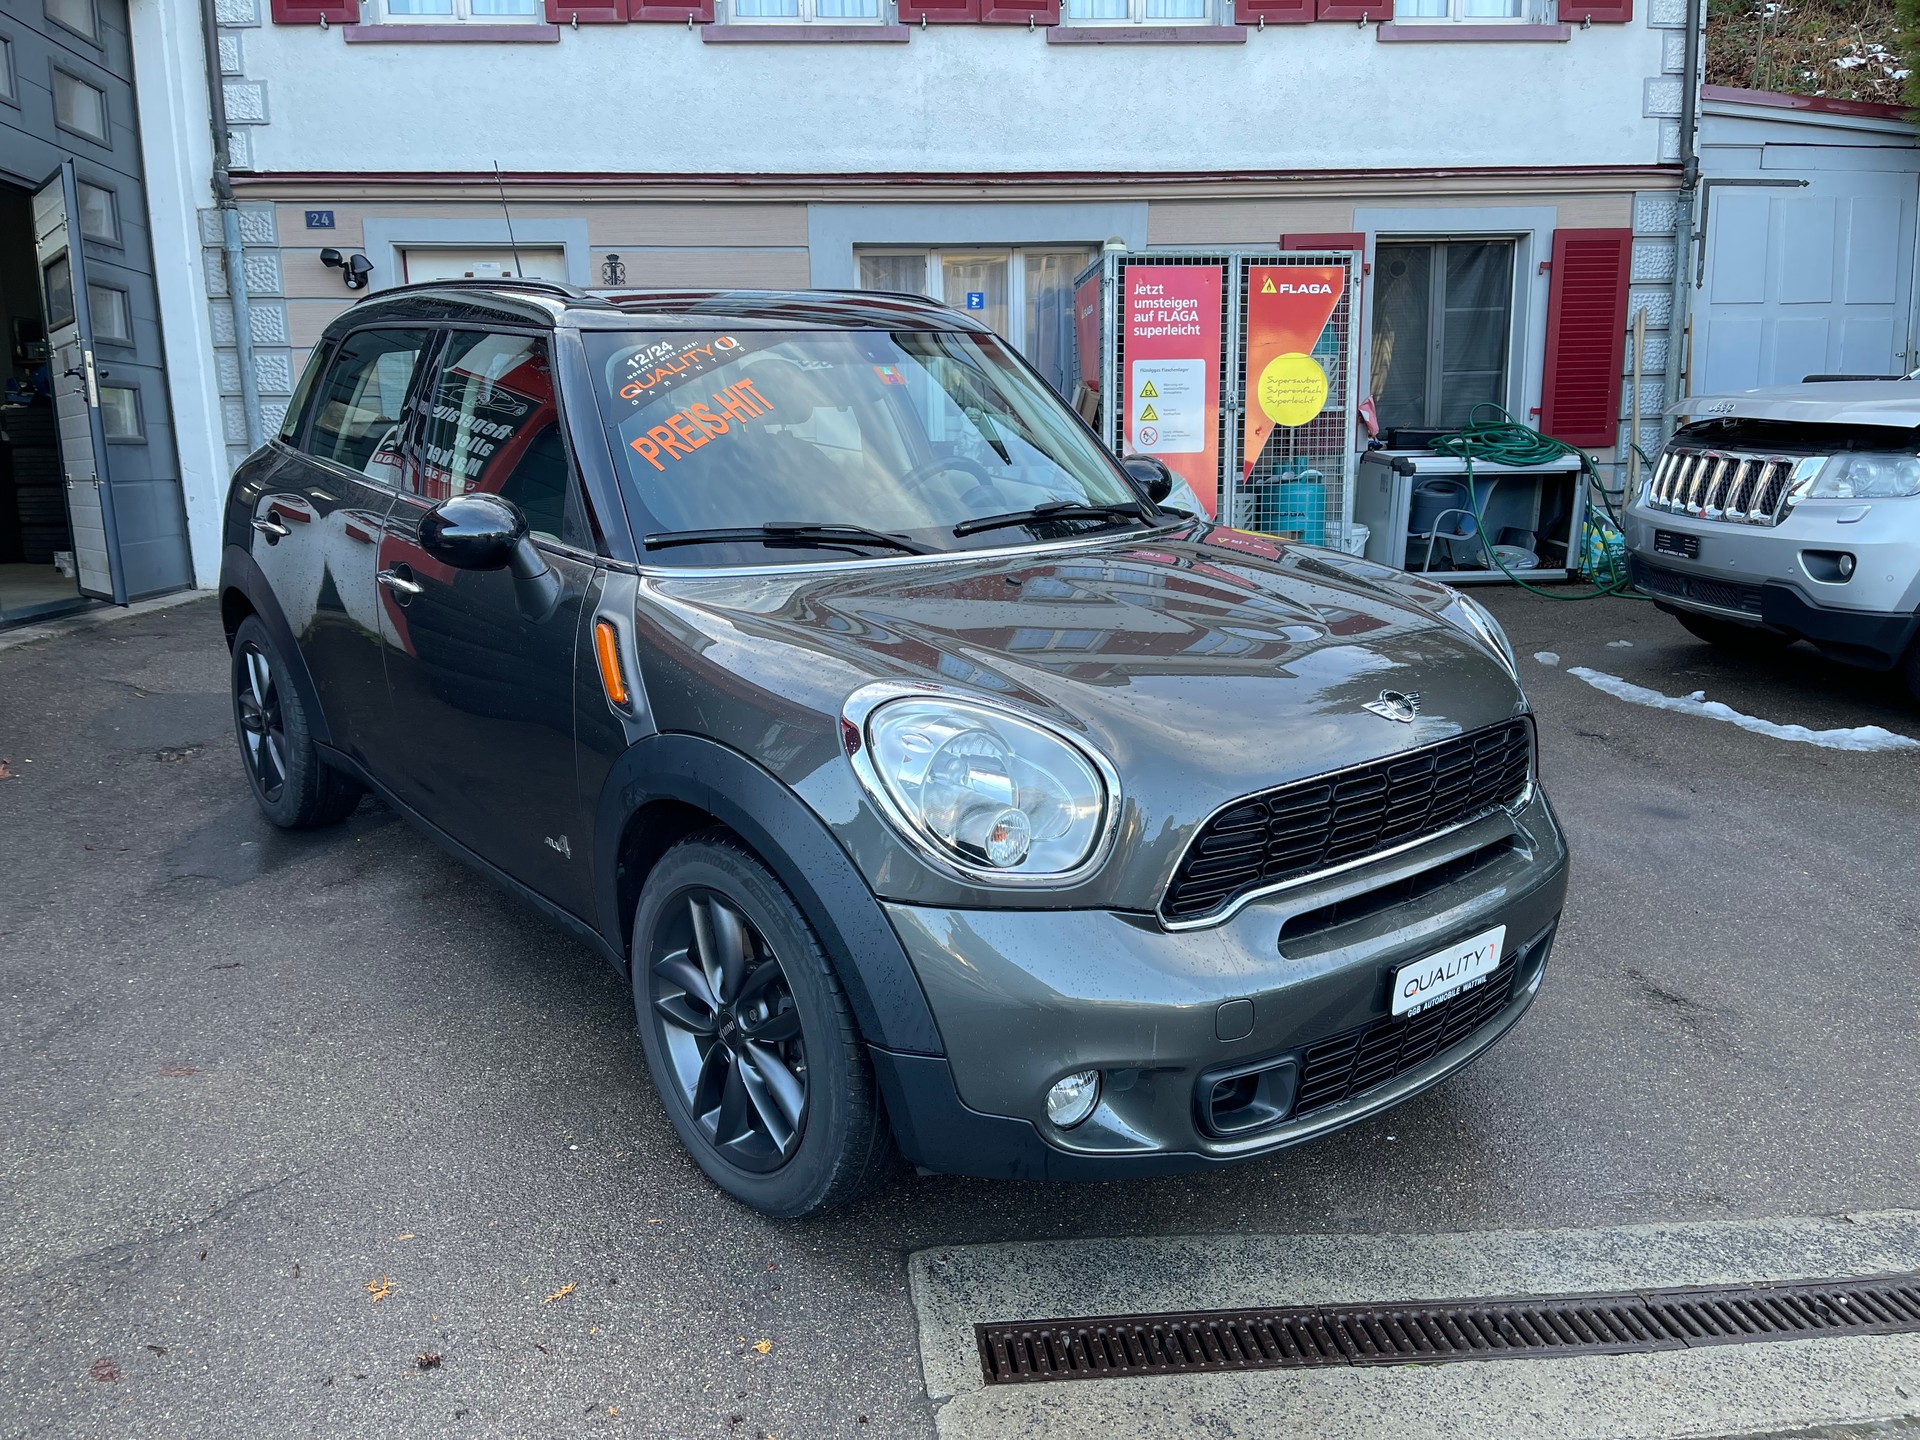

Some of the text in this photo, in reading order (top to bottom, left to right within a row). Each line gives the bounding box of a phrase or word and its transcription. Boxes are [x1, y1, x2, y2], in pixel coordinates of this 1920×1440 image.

[311, 213, 330, 226] 24
[1134, 283, 1164, 295] Jetzt
[1280, 284, 1332, 294] FLAGA
[1134, 297, 1198, 310] umsteigen
[1134, 310, 1199, 322] auf FLAGA
[1134, 324, 1201, 338] superleicht
[627, 341, 674, 369] 12/24
[620, 343, 714, 399] QUALITY
[627, 363, 654, 380] MONATE
[1267, 376, 1321, 386] Supersauber
[1708, 401, 1736, 415] Jeep
[630, 378, 774, 472] PREIS-HIT
[1388, 698, 1410, 710] MINI
[544, 829, 571, 860] ALL4
[1404, 943, 1496, 999] QUALITY 1
[1407, 975, 1488, 1018] GGB AUTOMOBILE WATTWIL
